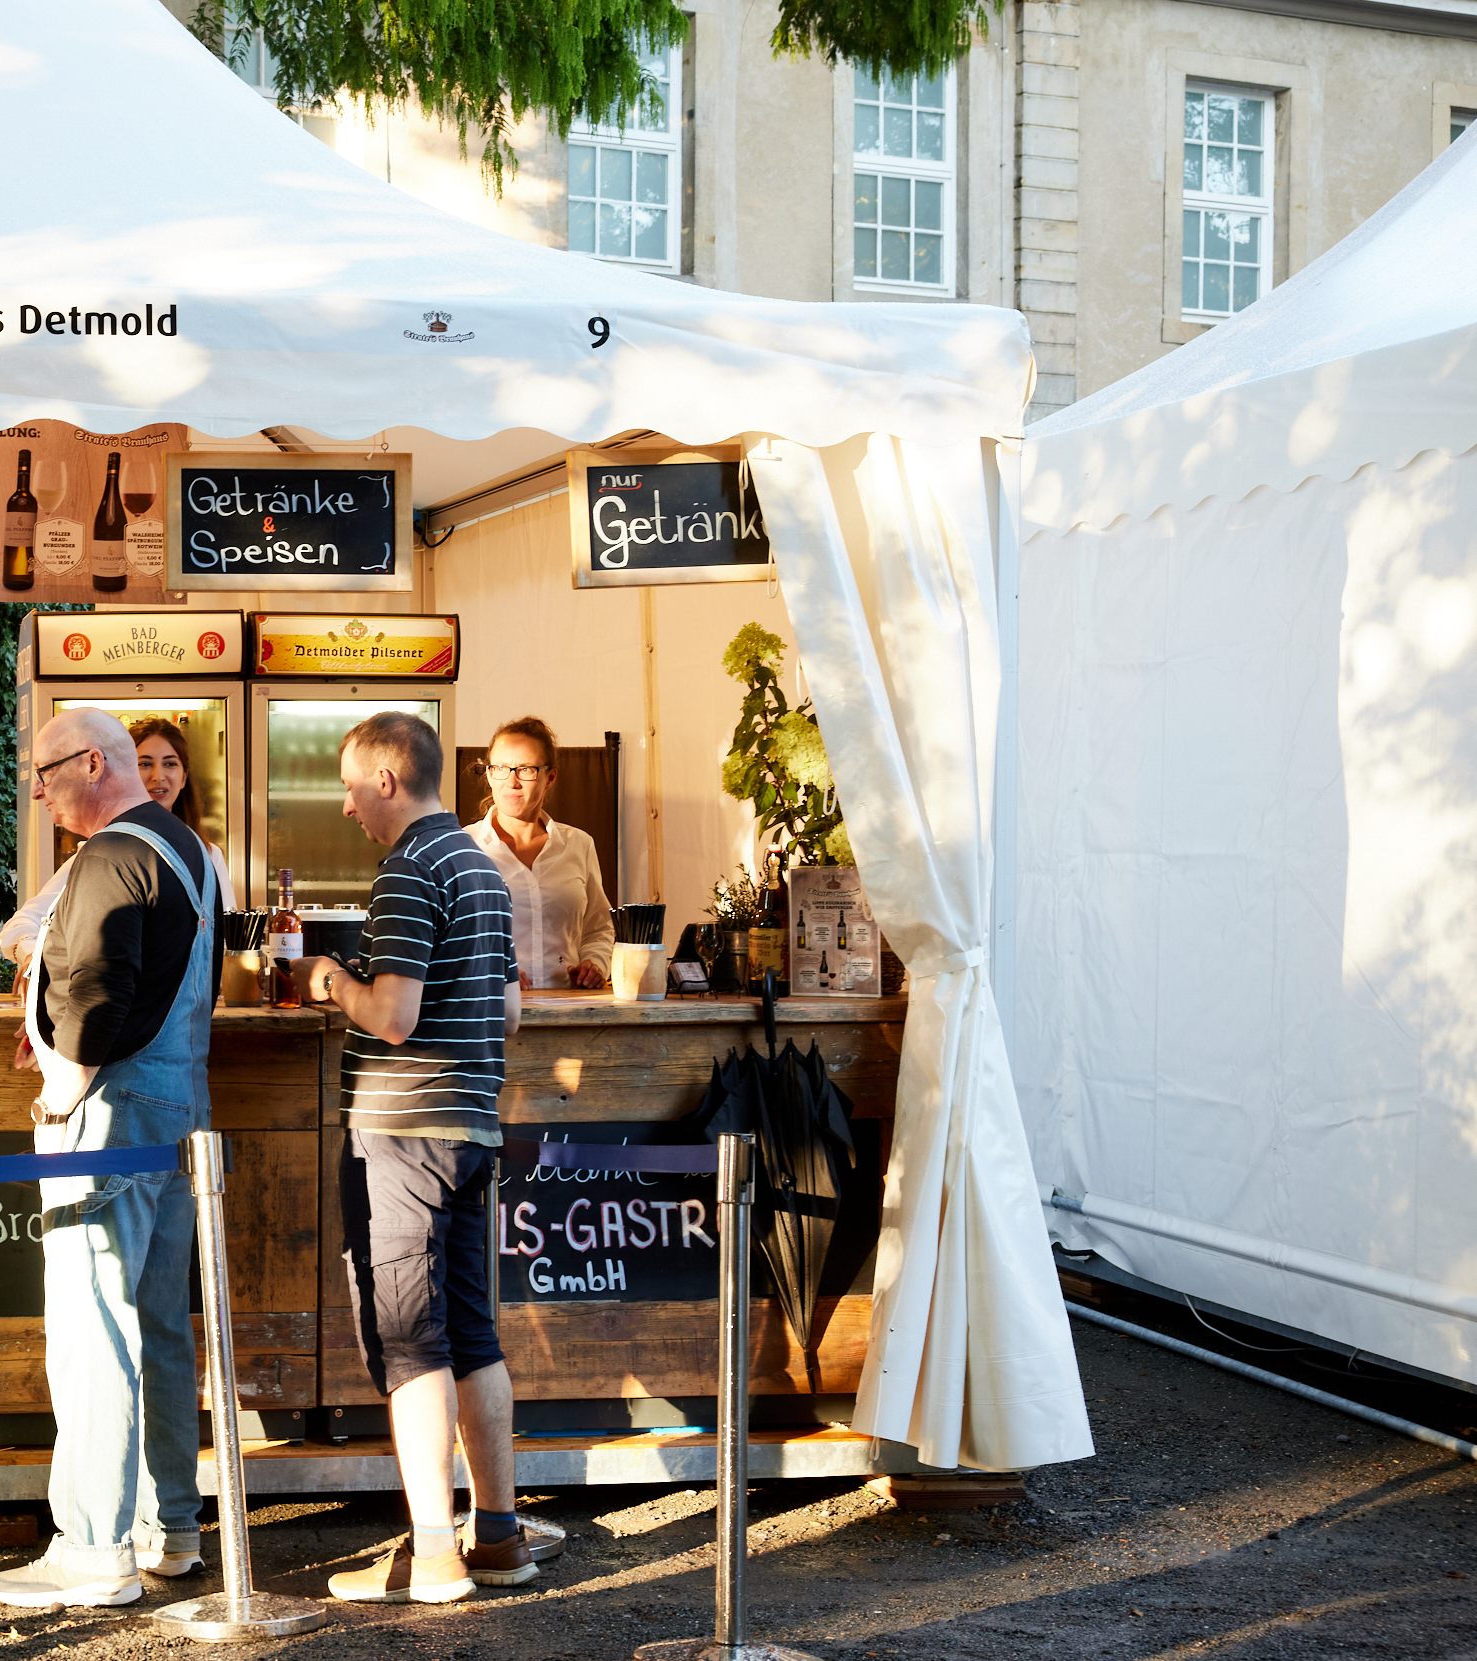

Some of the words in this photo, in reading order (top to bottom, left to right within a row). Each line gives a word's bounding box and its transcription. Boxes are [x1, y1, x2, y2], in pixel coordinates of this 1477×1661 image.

[19, 304, 178, 337] Detmold
[588, 316, 610, 349] 9
[188, 476, 359, 517] Getränke
[601, 474, 643, 487] nur
[189, 529, 339, 573] Speisen
[131, 627, 158, 640] BAD
[102, 641, 186, 663] MEINBERGER
[294, 645, 365, 657] Detmolder
[370, 645, 424, 659] Pilsener
[499, 1198, 720, 1257] LS-GASTR
[528, 1257, 627, 1293] GmbH
